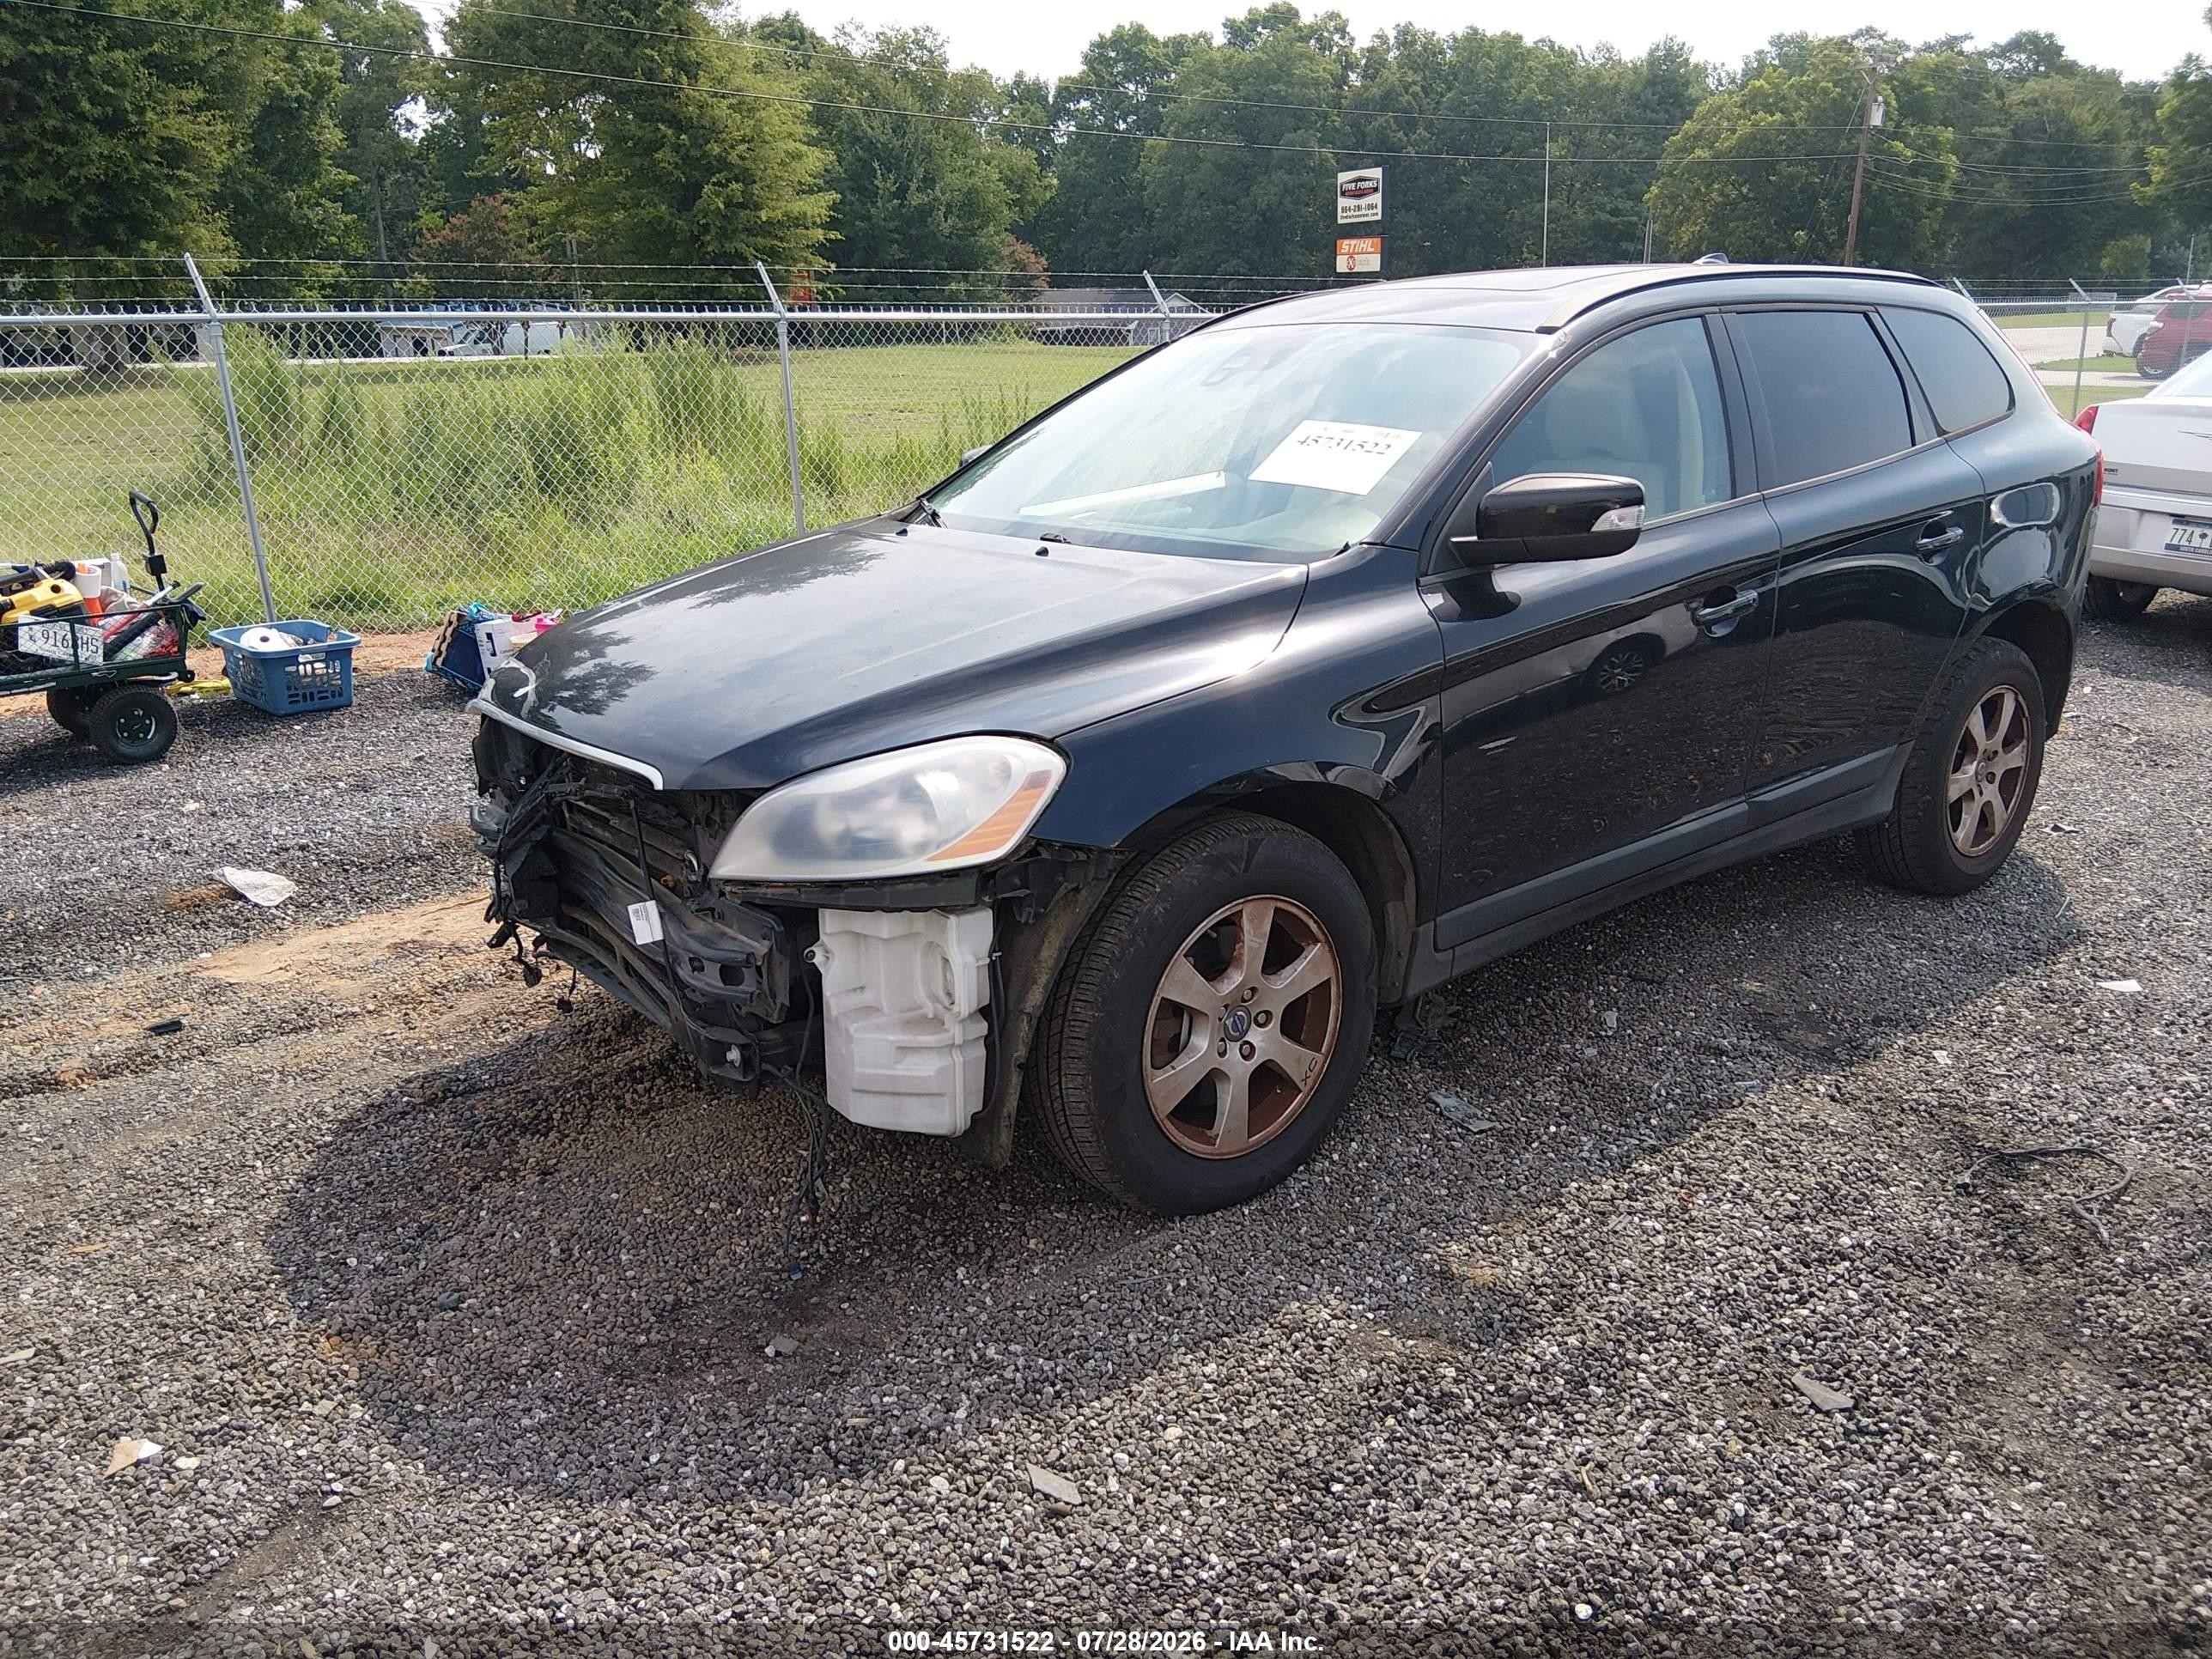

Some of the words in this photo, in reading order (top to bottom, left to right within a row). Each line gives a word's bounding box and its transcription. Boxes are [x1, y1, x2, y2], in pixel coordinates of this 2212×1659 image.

[1342, 182, 1357, 191] FIVE
[1357, 179, 1377, 189] FORKS
[1340, 240, 1375, 253] STIHL
[1297, 434, 1392, 455] 45731522
[2169, 527, 2195, 545] 774
